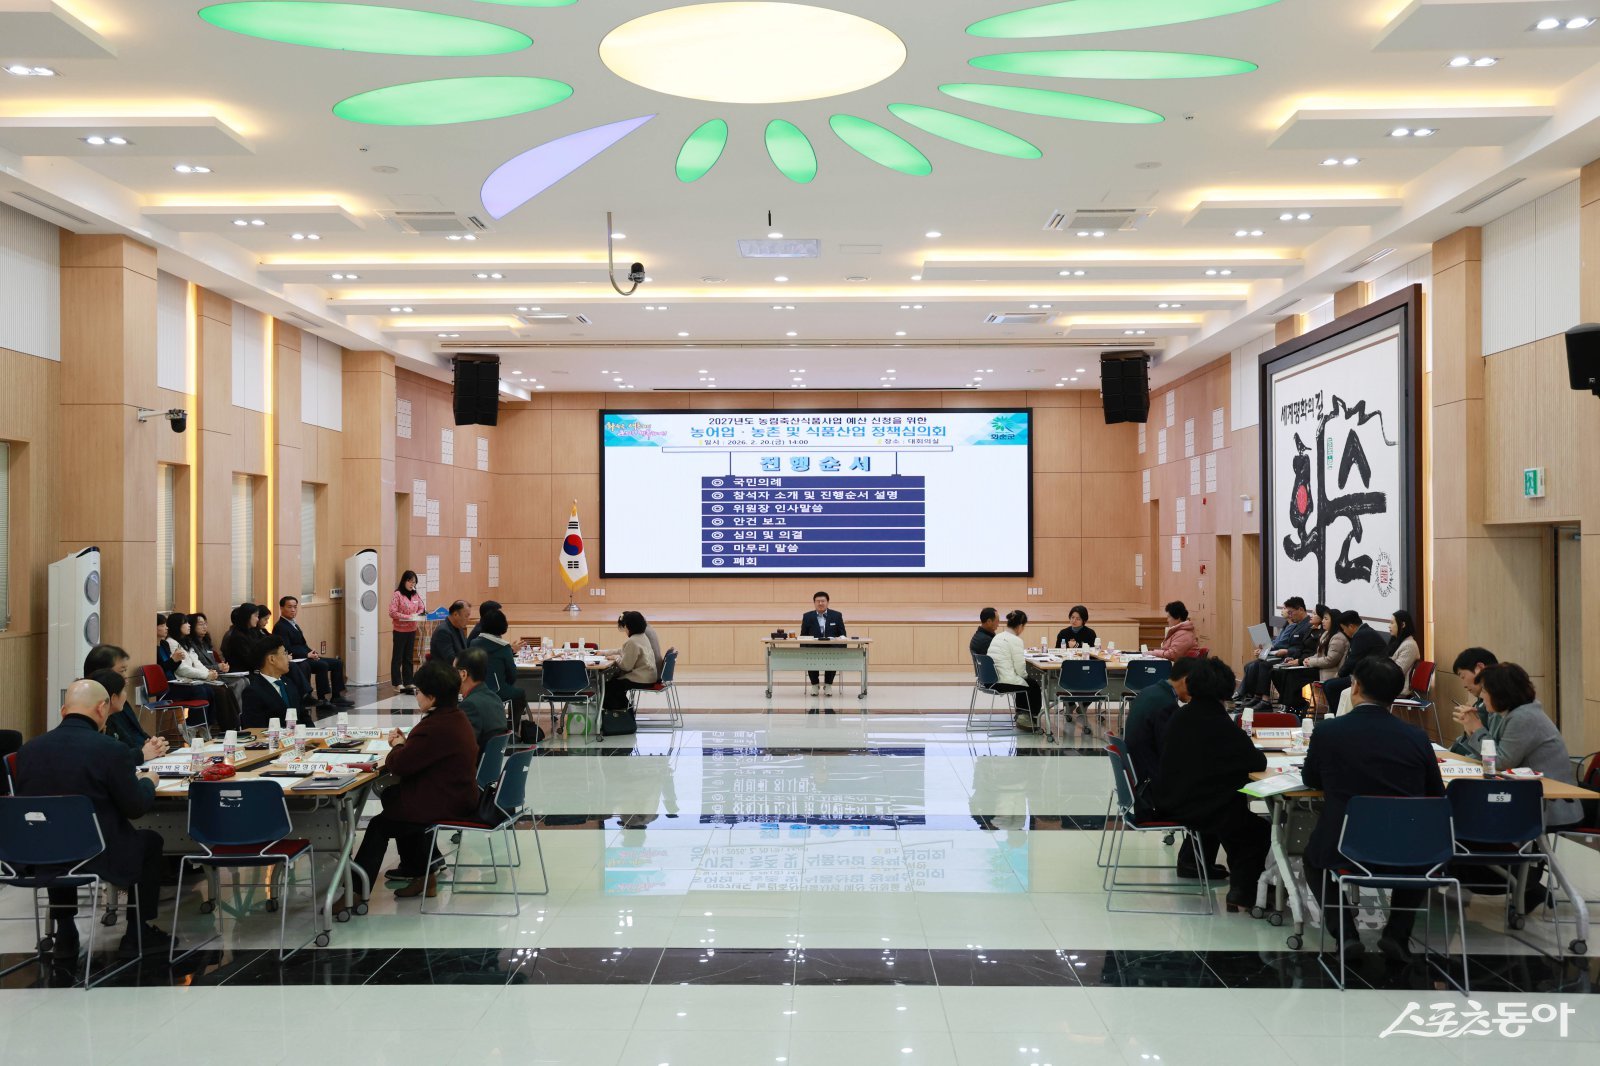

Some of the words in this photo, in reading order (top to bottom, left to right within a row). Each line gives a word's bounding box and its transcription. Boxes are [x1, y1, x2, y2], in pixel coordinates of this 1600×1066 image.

[709, 417, 754, 425] 2027년도
[759, 417, 842, 425] 농림축산식품사업
[846, 417, 867, 425] 예산
[871, 417, 902, 425] 신청을
[906, 417, 927, 425] 위한
[690, 426, 735, 438] 농어업
[752, 426, 780, 438] 농촌
[786, 426, 800, 438] 및
[806, 426, 866, 438] 식품산업
[872, 426, 946, 438] 정책심의회
[733, 478, 782, 487] 국민의례
[733, 491, 769, 500] 참석자
[774, 491, 799, 500] 소개
[804, 491, 815, 500] 및
[820, 491, 869, 500] 진행순서
[874, 491, 898, 500] 설명
[733, 504, 770, 513] 위원장
[775, 504, 823, 513] 인사말씀
[733, 517, 757, 526] 안건
[762, 517, 787, 526] 보고
[733, 530, 757, 540] 심의
[763, 530, 774, 540] 및
[779, 530, 803, 540] 의결
[733, 544, 769, 553] 마무리
[775, 544, 799, 553] 말씀
[733, 557, 757, 566] 폐회
